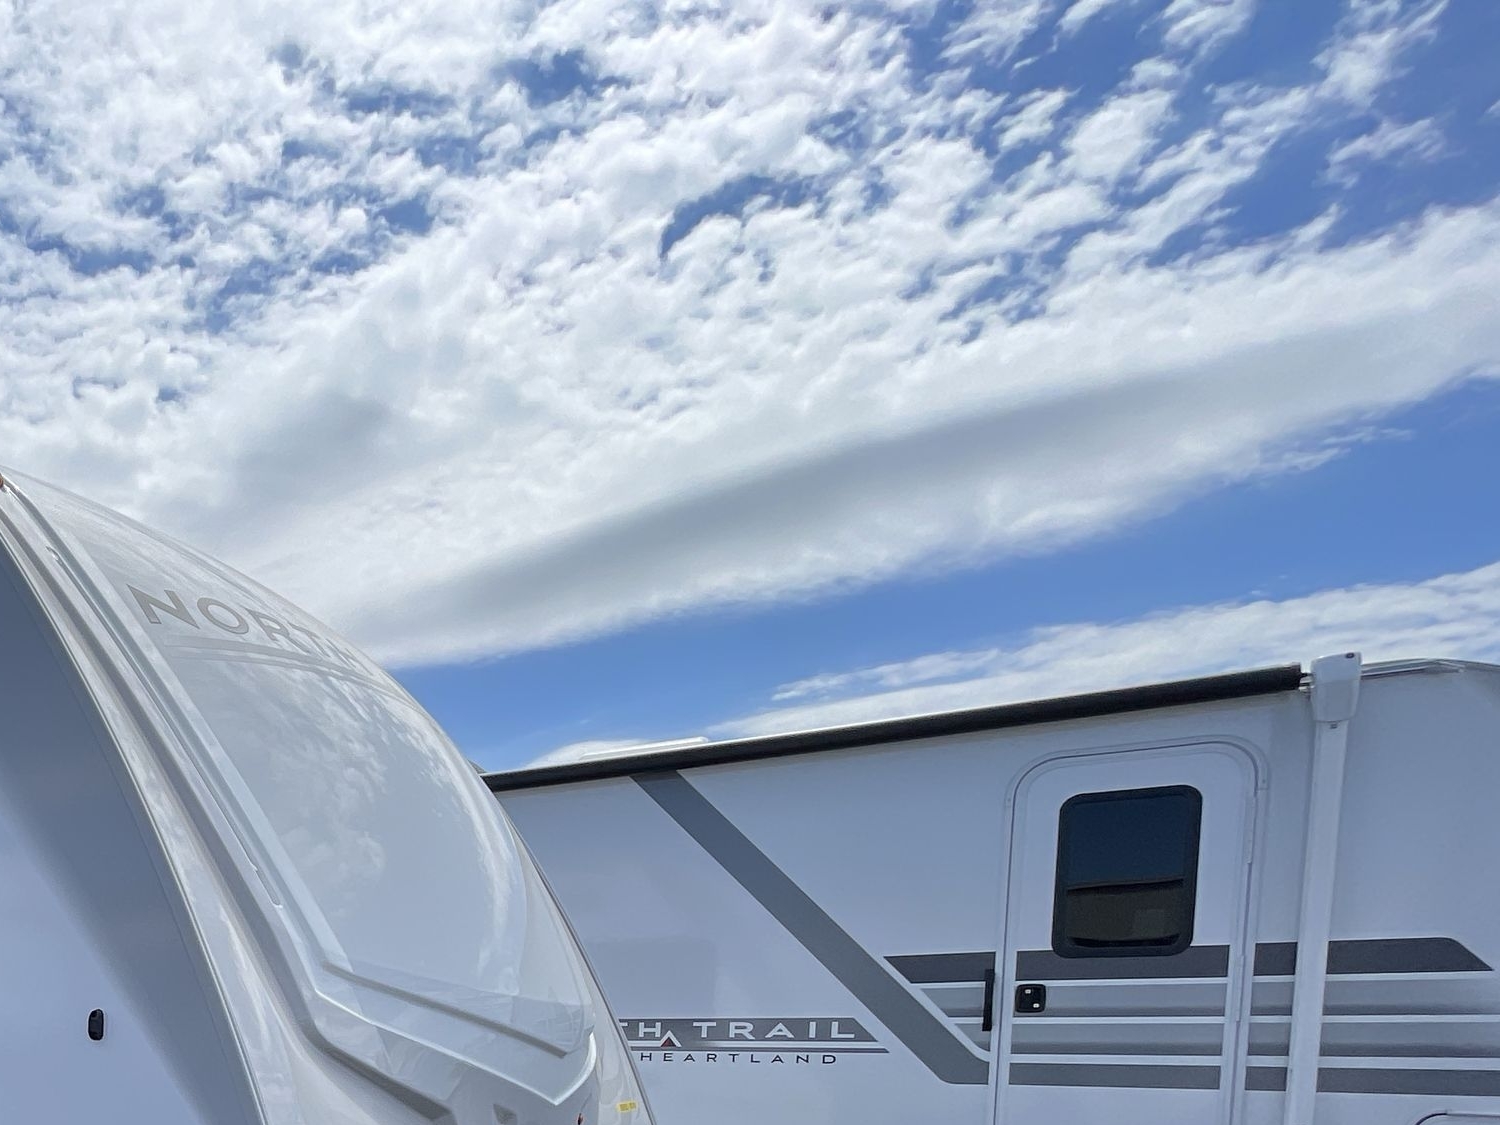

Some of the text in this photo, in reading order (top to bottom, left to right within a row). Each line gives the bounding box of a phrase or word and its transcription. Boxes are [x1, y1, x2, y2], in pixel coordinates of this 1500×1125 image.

[127, 583, 373, 676] NORTH
[693, 1020, 855, 1039] TRAIL
[639, 1052, 837, 1065] HEARTLAND
